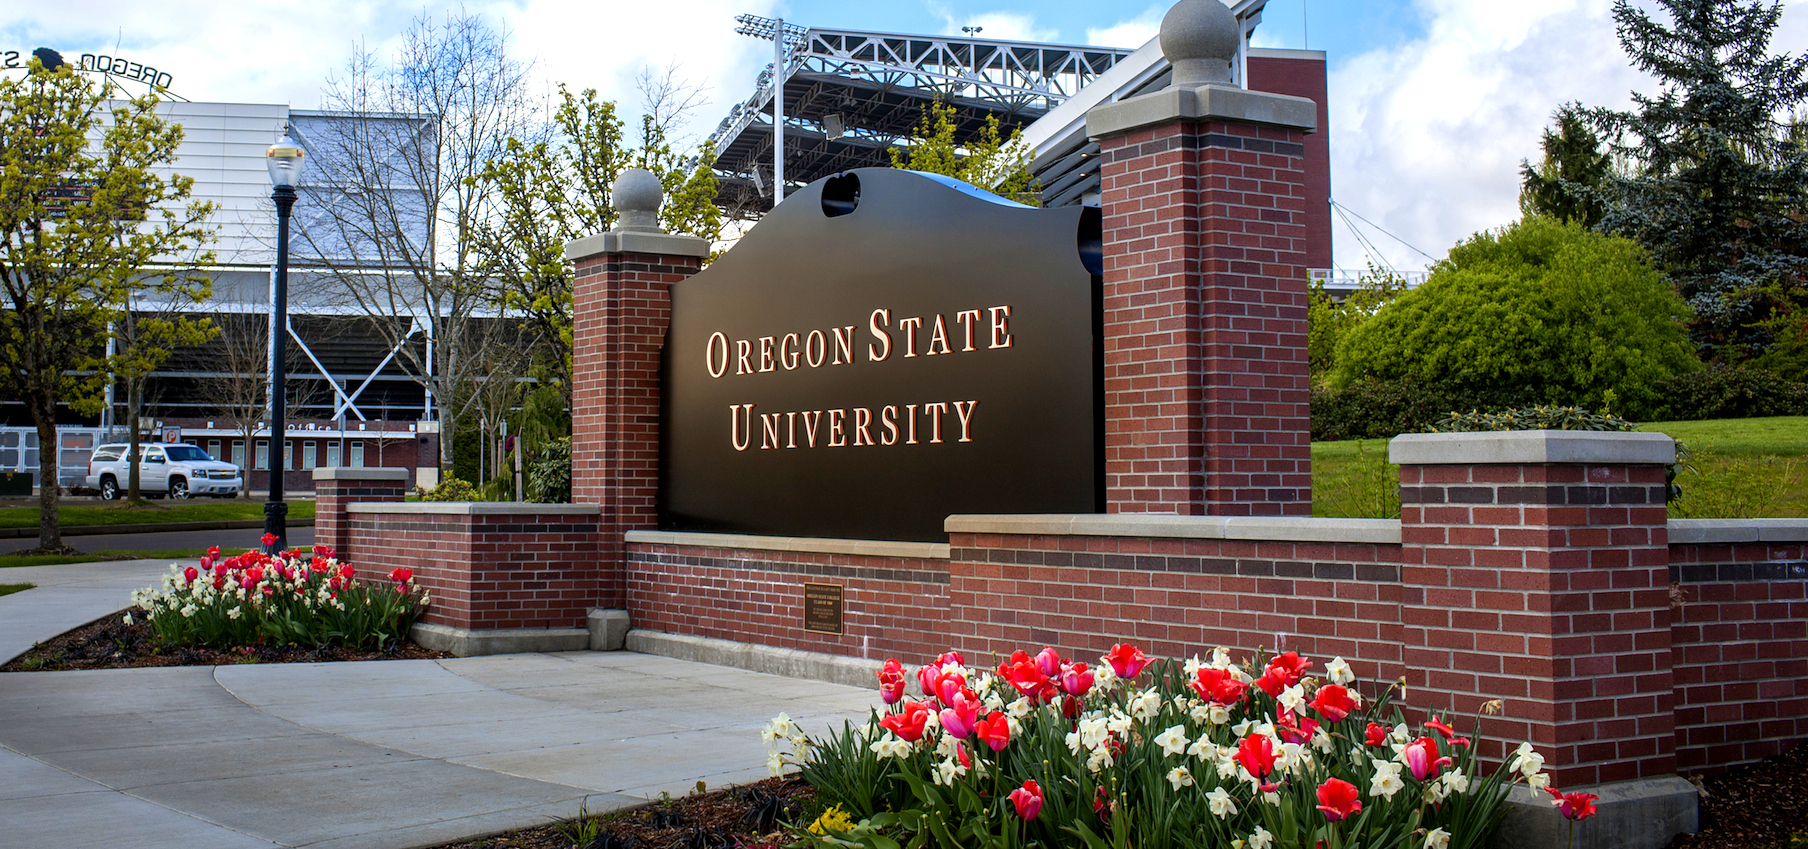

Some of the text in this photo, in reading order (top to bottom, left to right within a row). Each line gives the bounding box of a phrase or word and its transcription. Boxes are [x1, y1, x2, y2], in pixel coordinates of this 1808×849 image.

[706, 305, 1013, 379] OREGON STATE
[288, 423, 332, 433] Offce
[730, 400, 979, 452] UNIVERSITY
